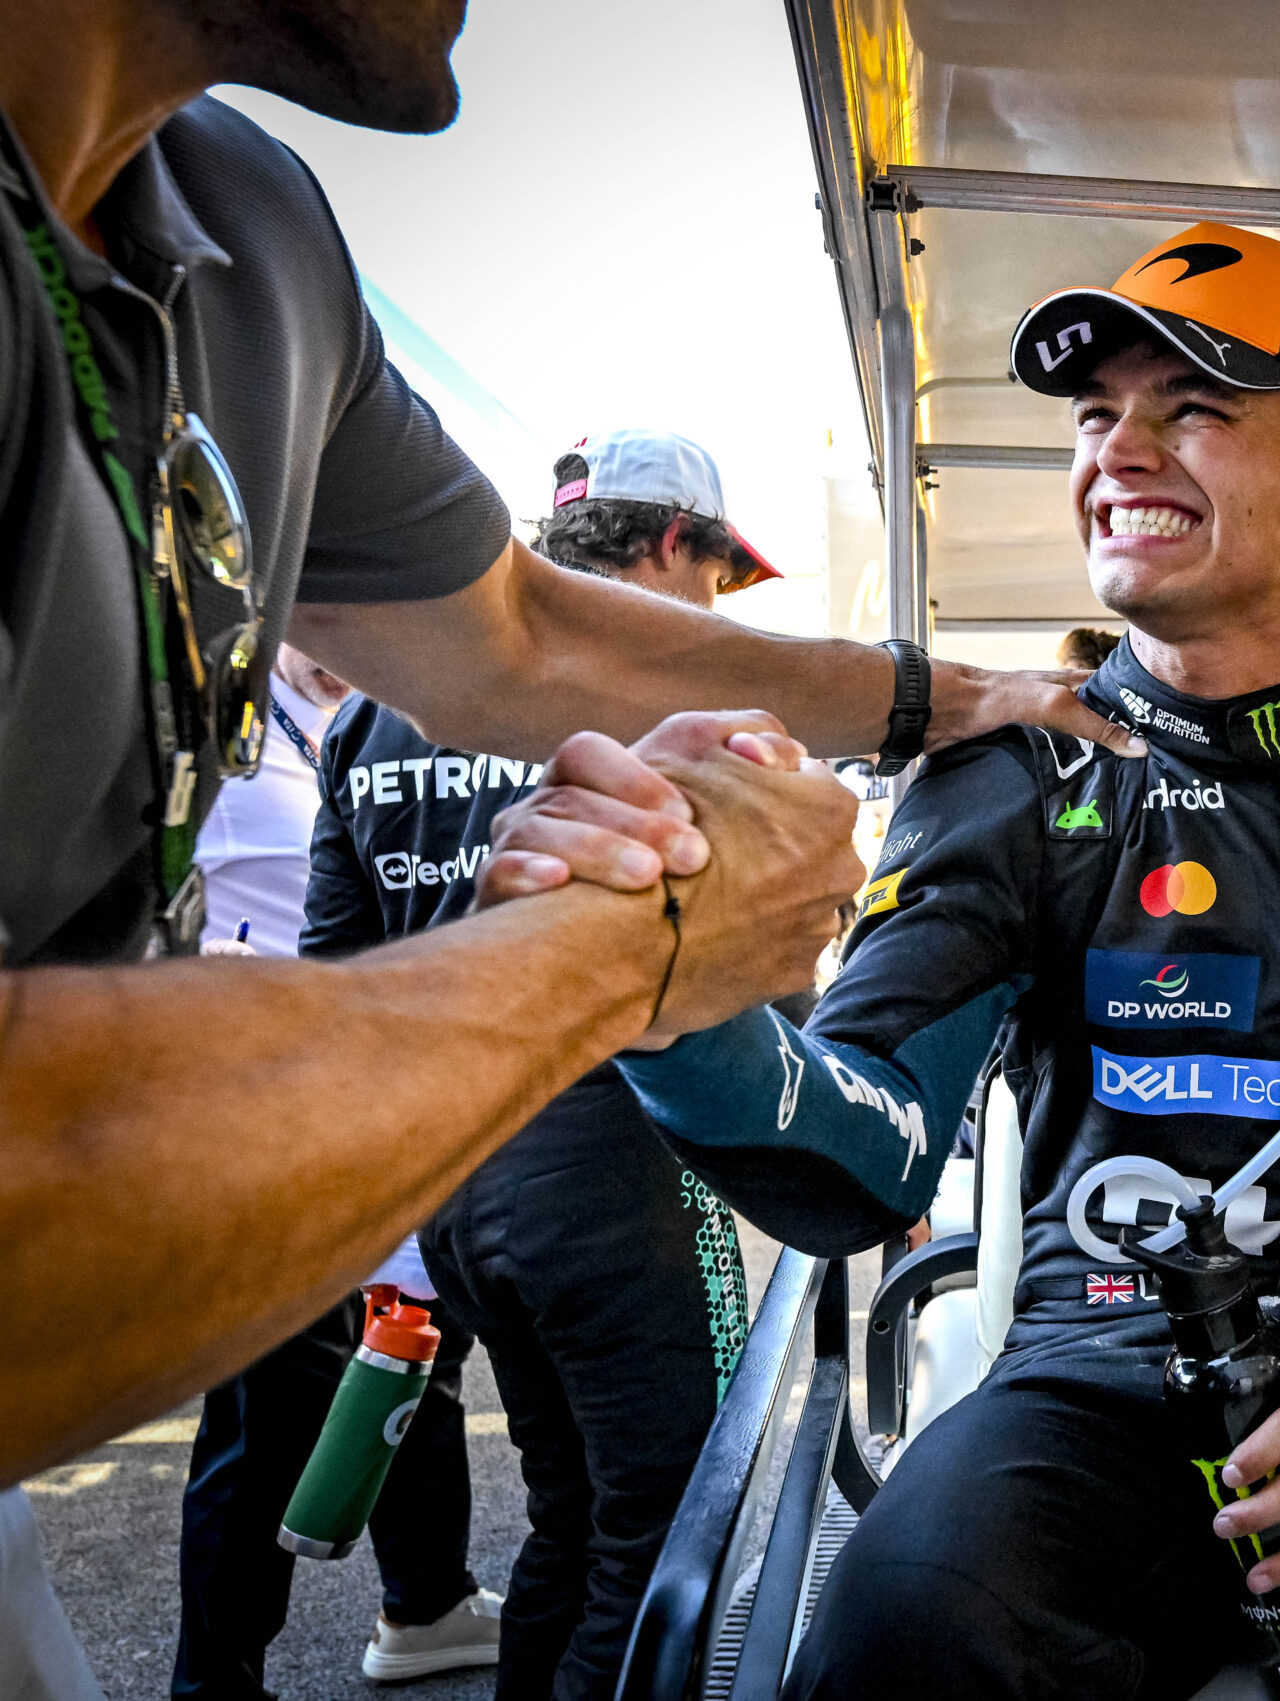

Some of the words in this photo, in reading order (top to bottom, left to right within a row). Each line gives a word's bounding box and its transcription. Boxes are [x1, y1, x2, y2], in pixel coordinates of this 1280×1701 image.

[1152, 716, 1210, 745] NUTRITION
[1156, 708, 1204, 734] OPTIMUM
[1142, 778, 1226, 812] ndroid
[1107, 1000, 1141, 1019] DP
[1144, 1000, 1232, 1020] WORLD
[1101, 1058, 1213, 1101] DELL
